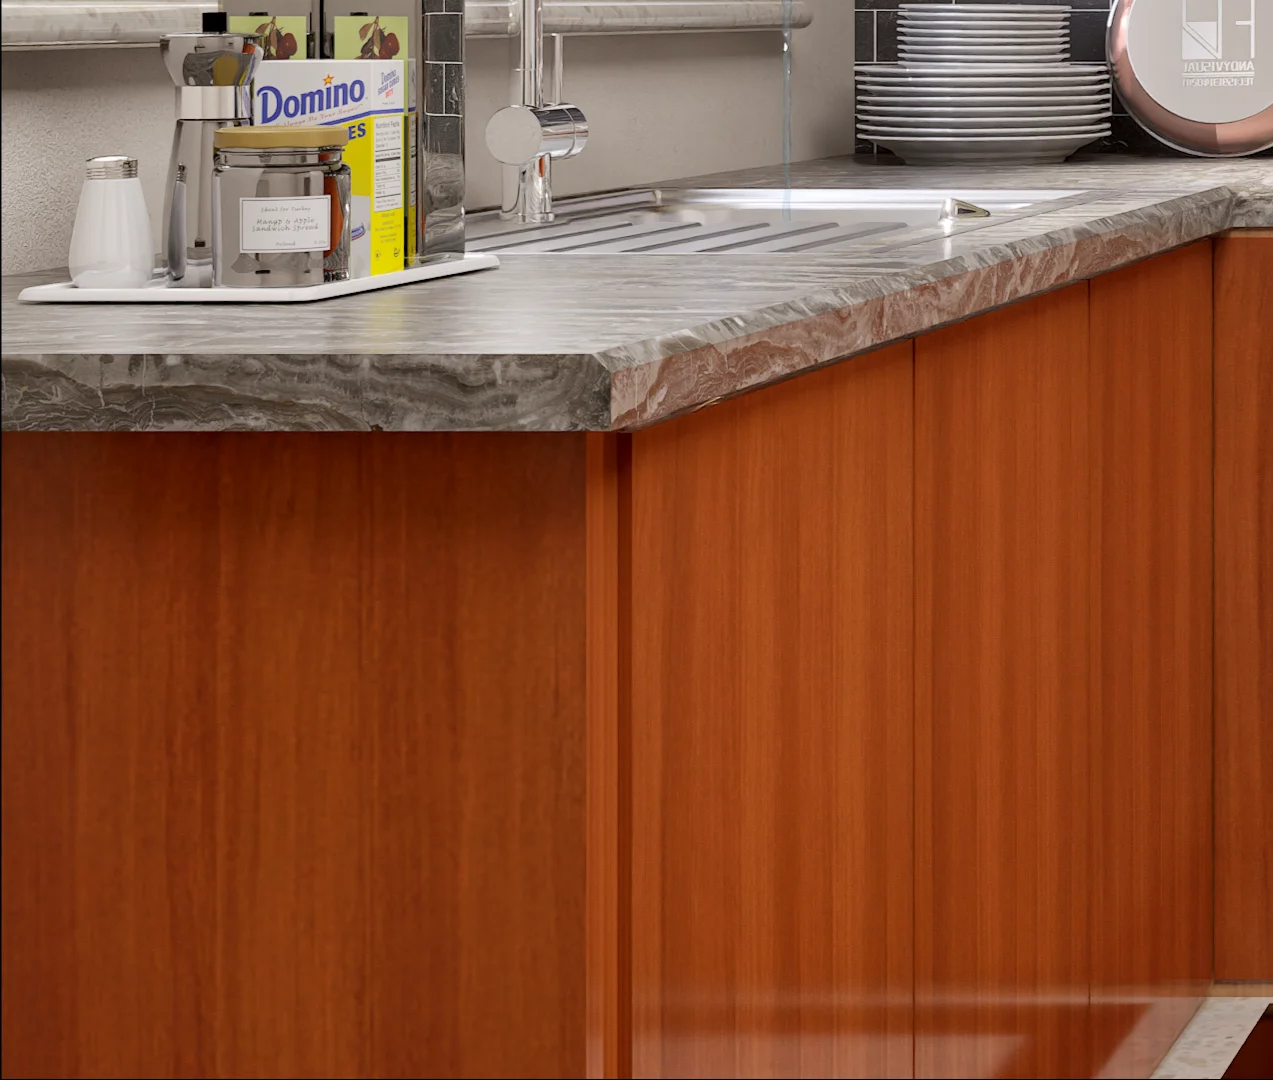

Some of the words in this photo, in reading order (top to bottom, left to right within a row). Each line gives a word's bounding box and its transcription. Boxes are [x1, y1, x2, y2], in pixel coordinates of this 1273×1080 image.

[257, 75, 365, 124] Domino
[348, 123, 366, 140] ES
[252, 224, 290, 232] Sandwich
[293, 223, 319, 232] Spread
